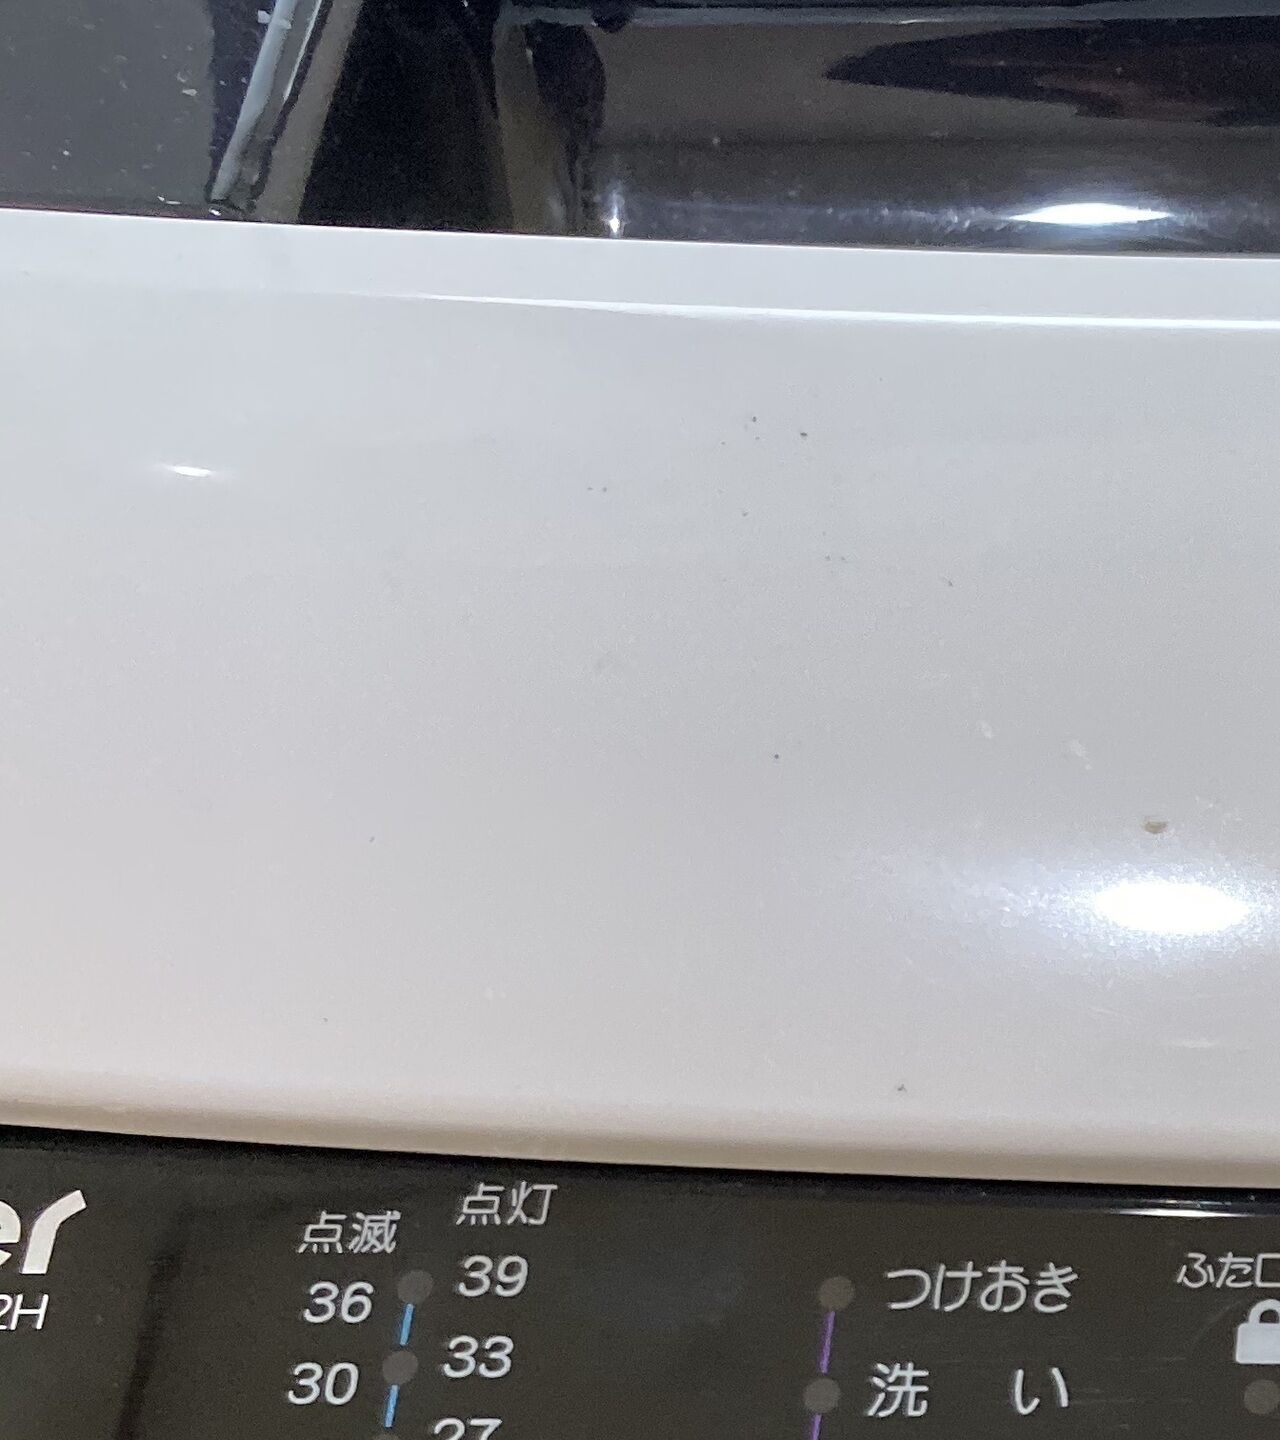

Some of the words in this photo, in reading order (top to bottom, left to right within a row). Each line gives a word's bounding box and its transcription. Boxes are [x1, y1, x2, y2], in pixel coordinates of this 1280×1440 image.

[454, 1179, 559, 1227] 点灯
[296, 1209, 402, 1255] 点滅
[456, 1254, 529, 1298] 39
[885, 1258, 1079, 1314] つけおき
[302, 1280, 375, 1324] 36
[441, 1334, 515, 1379] 33
[286, 1361, 360, 1406] 30
